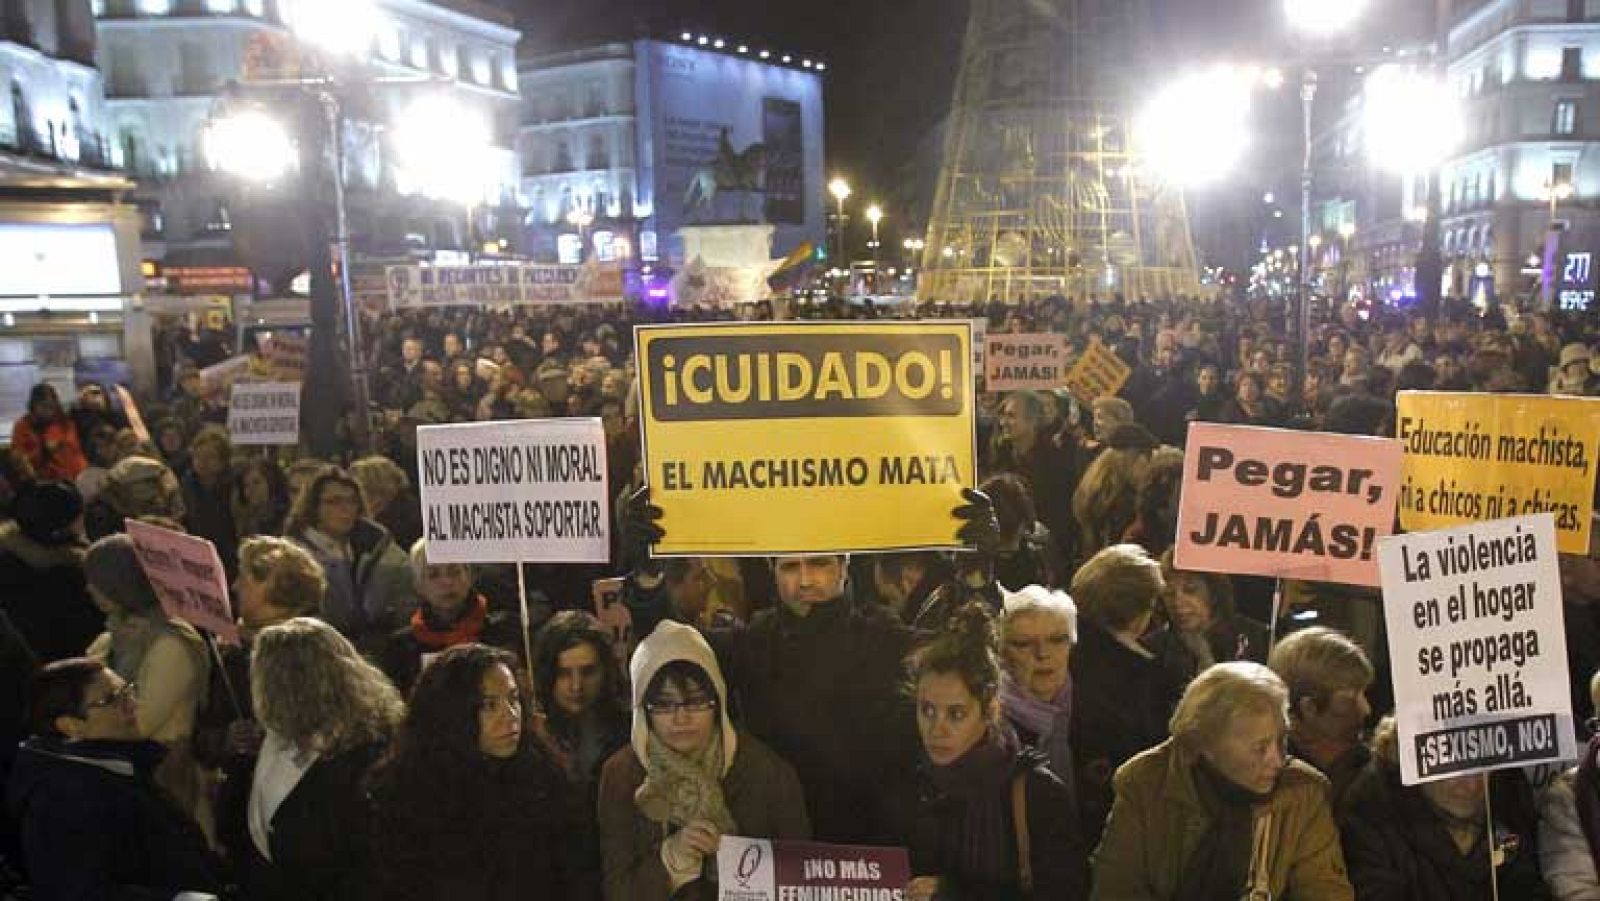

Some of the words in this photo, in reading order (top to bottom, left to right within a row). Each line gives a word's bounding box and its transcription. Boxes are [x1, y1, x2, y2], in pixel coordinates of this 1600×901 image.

[989, 341, 1058, 358] Pegar,
[662, 350, 954, 405] ¡CUIDADO!
[424, 448, 446, 486] NO
[451, 448, 470, 484] ES
[474, 446, 522, 484] DIGNO
[526, 445, 542, 482] NI
[545, 444, 602, 482] MORAL
[1401, 417, 1491, 460] Educación
[1497, 424, 1589, 477] machista,
[662, 461, 692, 490] EL
[703, 456, 868, 489] MACHISMO
[879, 455, 961, 485] MATA
[1197, 446, 1383, 504] Pegar,
[428, 504, 447, 540] AL
[449, 502, 521, 540] MACHISTA
[524, 499, 604, 539] SOPORTAR.
[1401, 475, 1413, 509] ni
[1416, 487, 1424, 512] a
[1429, 476, 1482, 518] chicos
[1485, 484, 1503, 520] ni
[1507, 498, 1517, 517] a
[1190, 512, 1376, 561] JAMÁS!
[1401, 544, 1431, 582] La
[1437, 524, 1537, 577] violencia
[1413, 597, 1441, 628] en
[1447, 583, 1467, 623] el
[1472, 581, 1537, 622] hogar
[1417, 644, 1444, 676] se
[1450, 629, 1540, 678] propaga
[1433, 679, 1478, 721] más
[1484, 671, 1533, 712] allá.
[1420, 726, 1513, 775] ¡SEXISMO,
[1518, 719, 1554, 752] NO!
[778, 885, 903, 901] FEMINICIDIOS
[803, 858, 836, 880] ¡NO
[840, 859, 881, 880] MÁS
